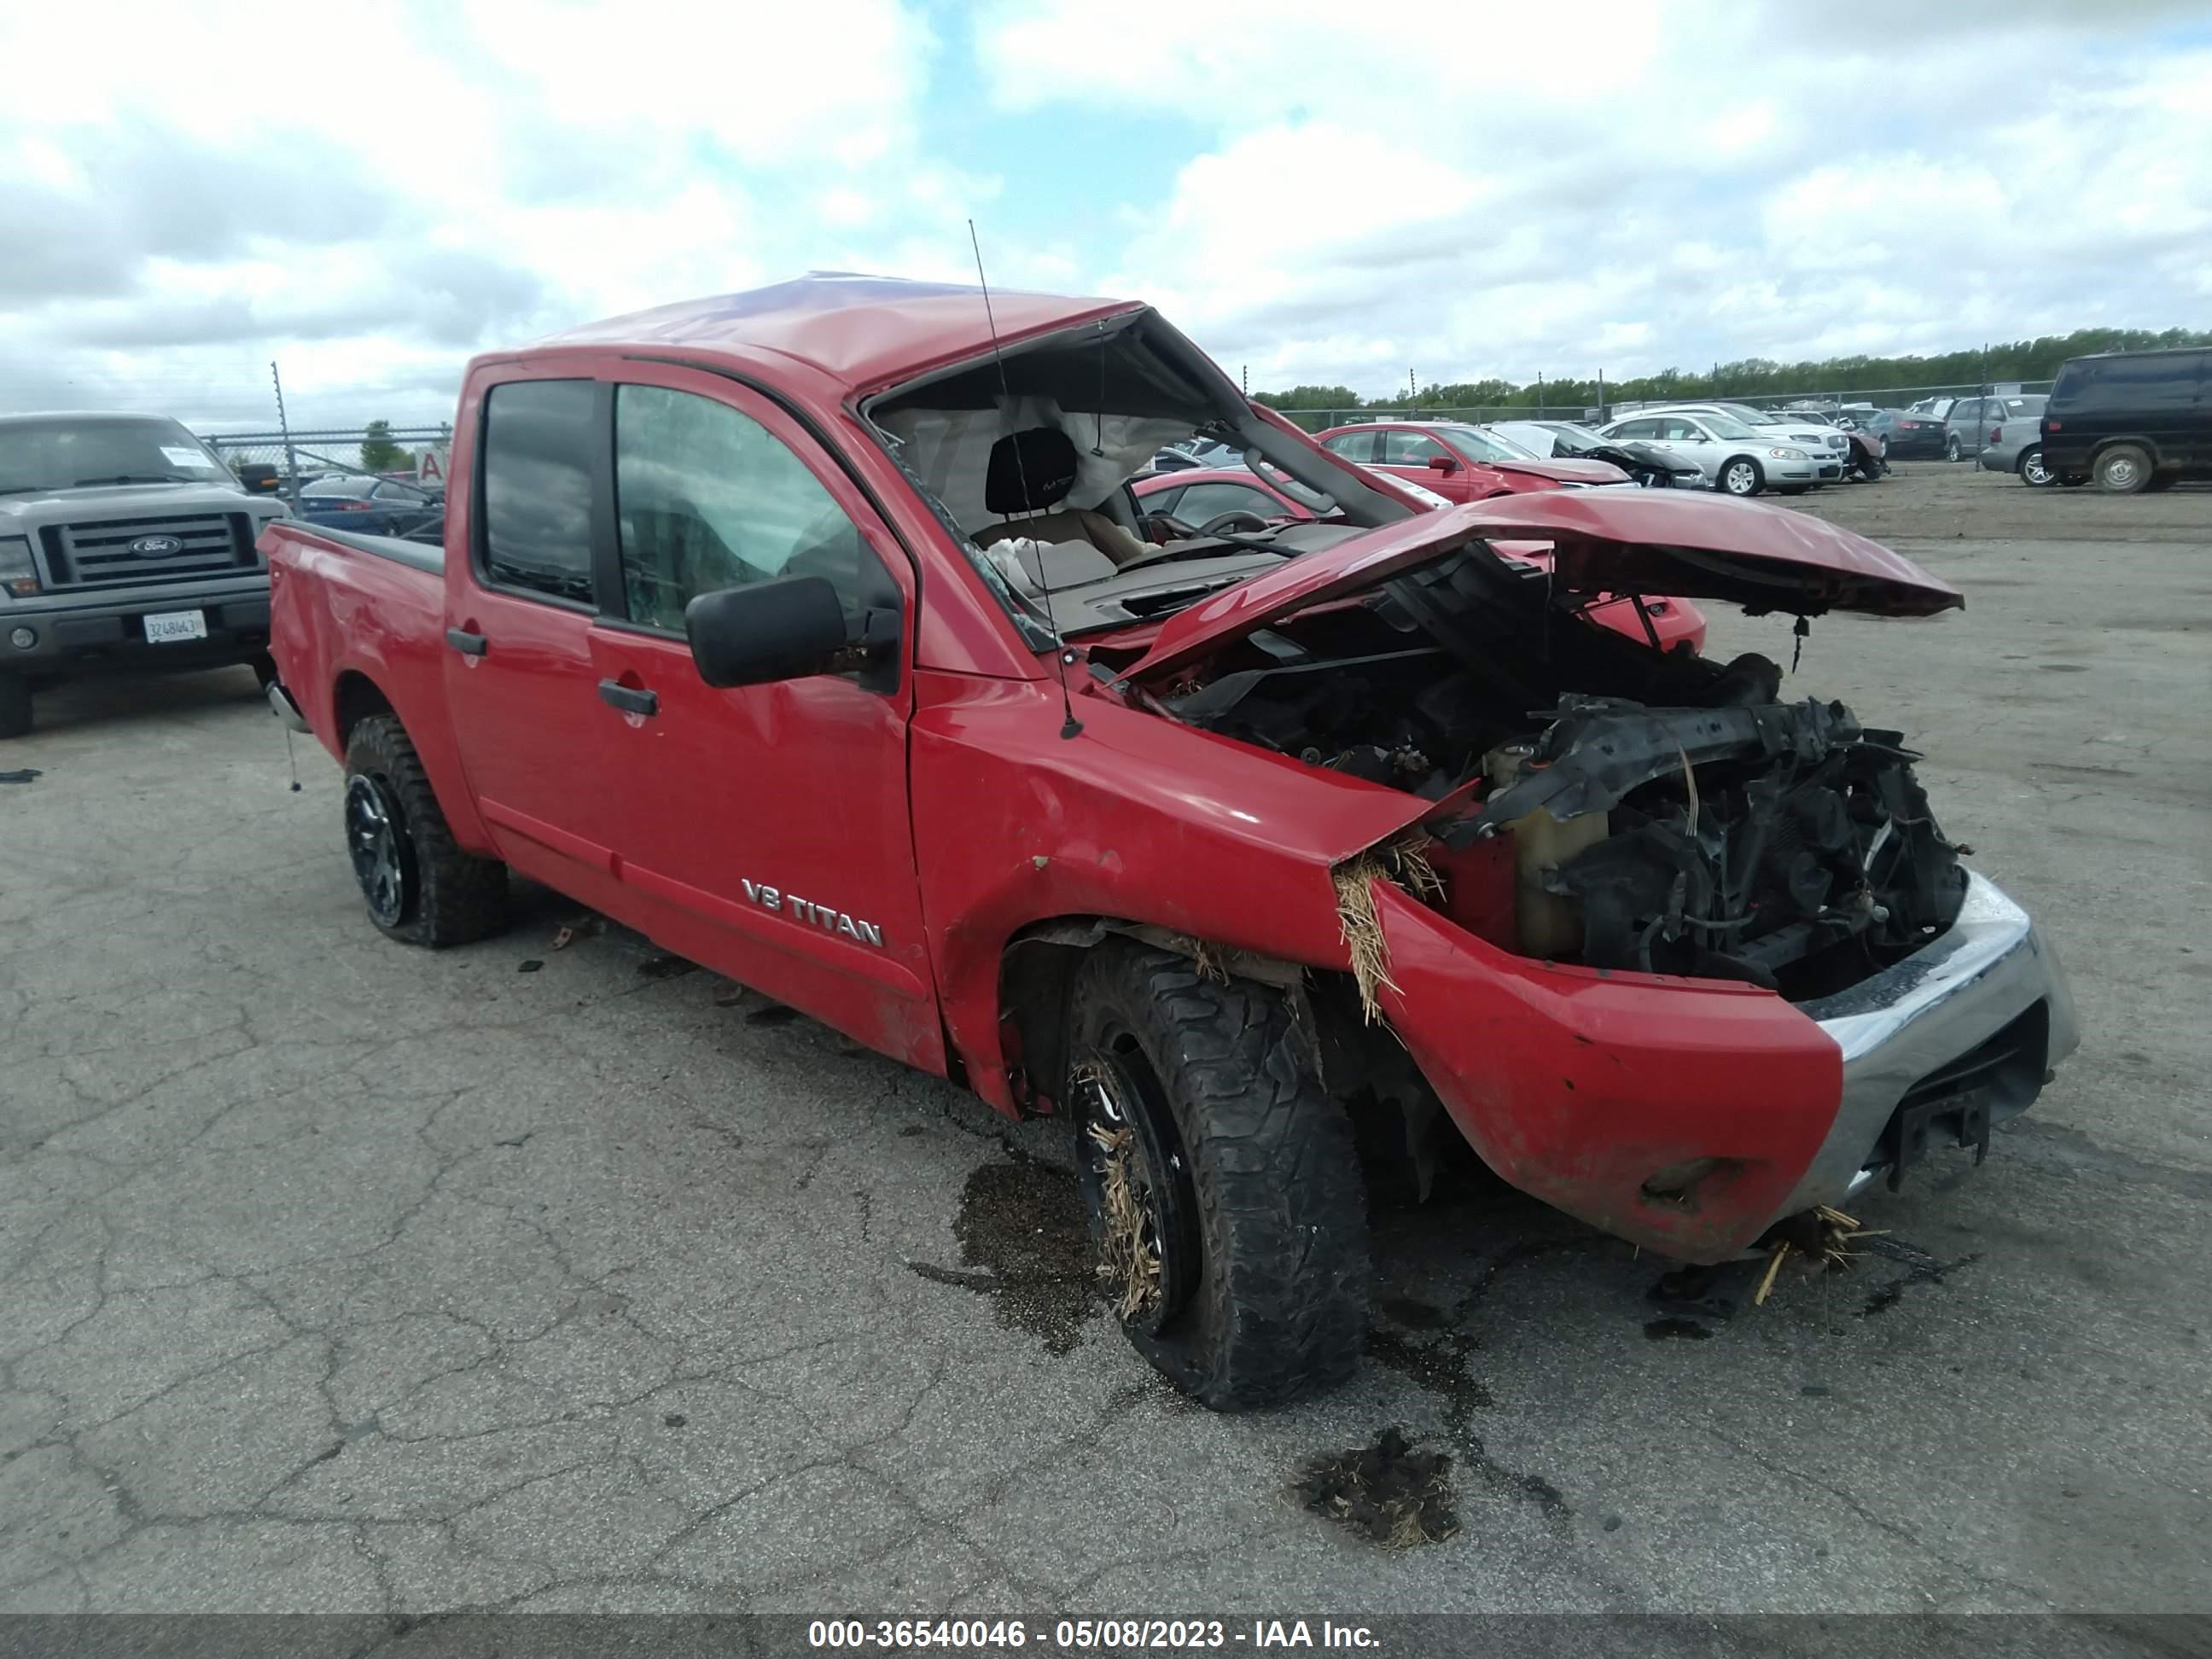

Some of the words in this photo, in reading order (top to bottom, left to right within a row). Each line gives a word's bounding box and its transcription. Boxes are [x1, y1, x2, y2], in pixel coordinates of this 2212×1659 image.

[421, 453, 442, 480] A
[742, 878, 782, 911] V8
[787, 894, 884, 948] TITAN
